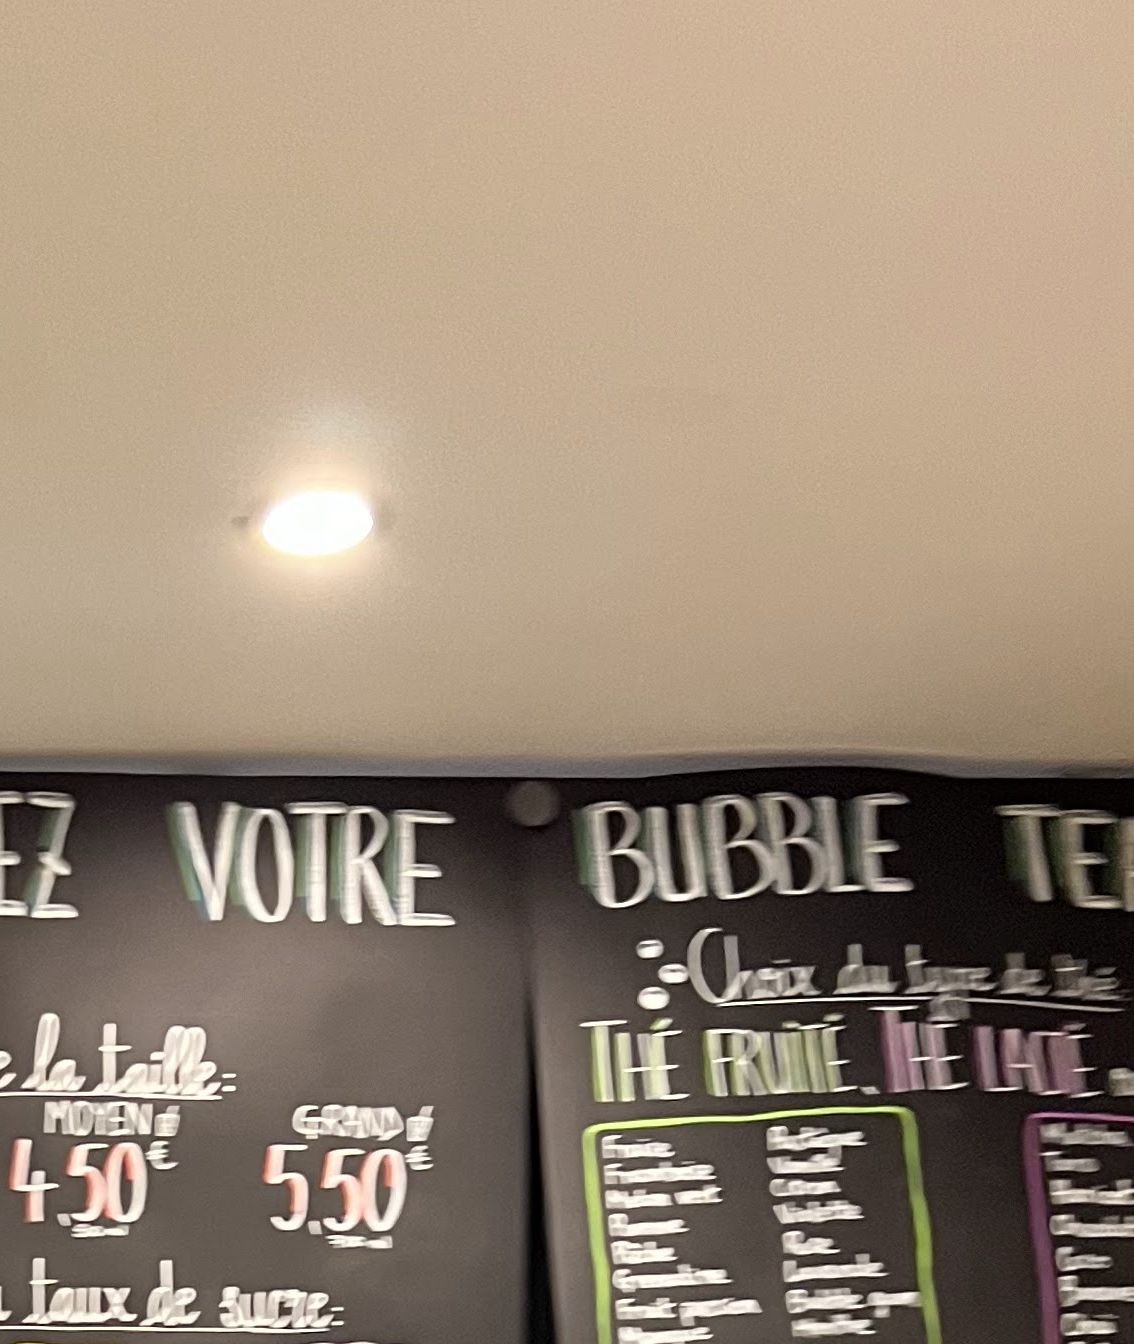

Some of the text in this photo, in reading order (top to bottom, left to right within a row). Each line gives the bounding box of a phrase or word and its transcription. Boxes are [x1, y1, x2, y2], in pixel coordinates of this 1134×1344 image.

[169, 802, 456, 926] VOTRE
[573, 791, 1134, 914] BUBBLE TE
[686, 927, 823, 1005] Choix
[23, 1013, 86, 1091] la
[43, 1100, 152, 1135] MOYEN
[21, 1258, 136, 1325] taux
[141, 1260, 200, 1327] de
